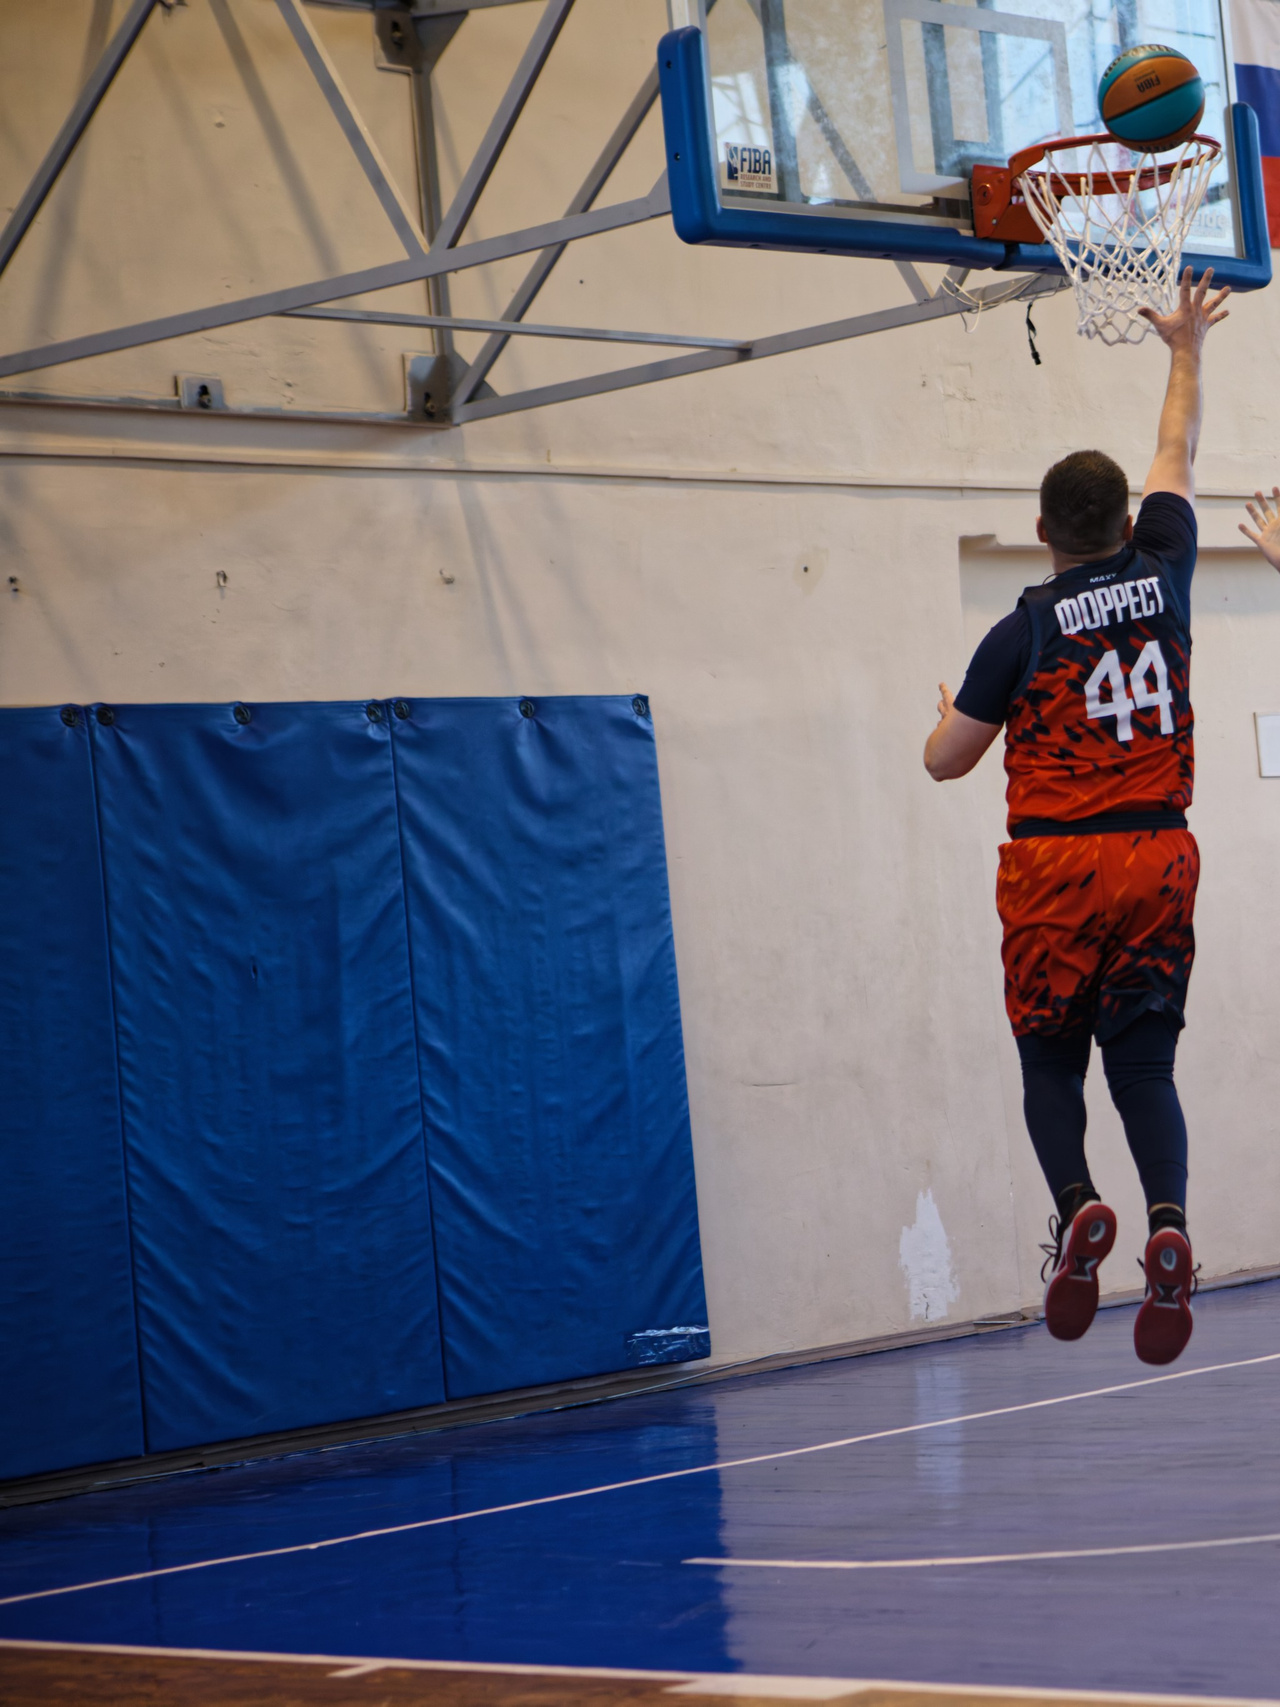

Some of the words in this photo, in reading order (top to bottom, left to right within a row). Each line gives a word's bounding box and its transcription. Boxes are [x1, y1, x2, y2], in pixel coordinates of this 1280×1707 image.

[740, 147, 771, 175] FIBA
[1054, 576, 1164, 635] ФОРРЕСТ
[1084, 640, 1174, 742] 44
